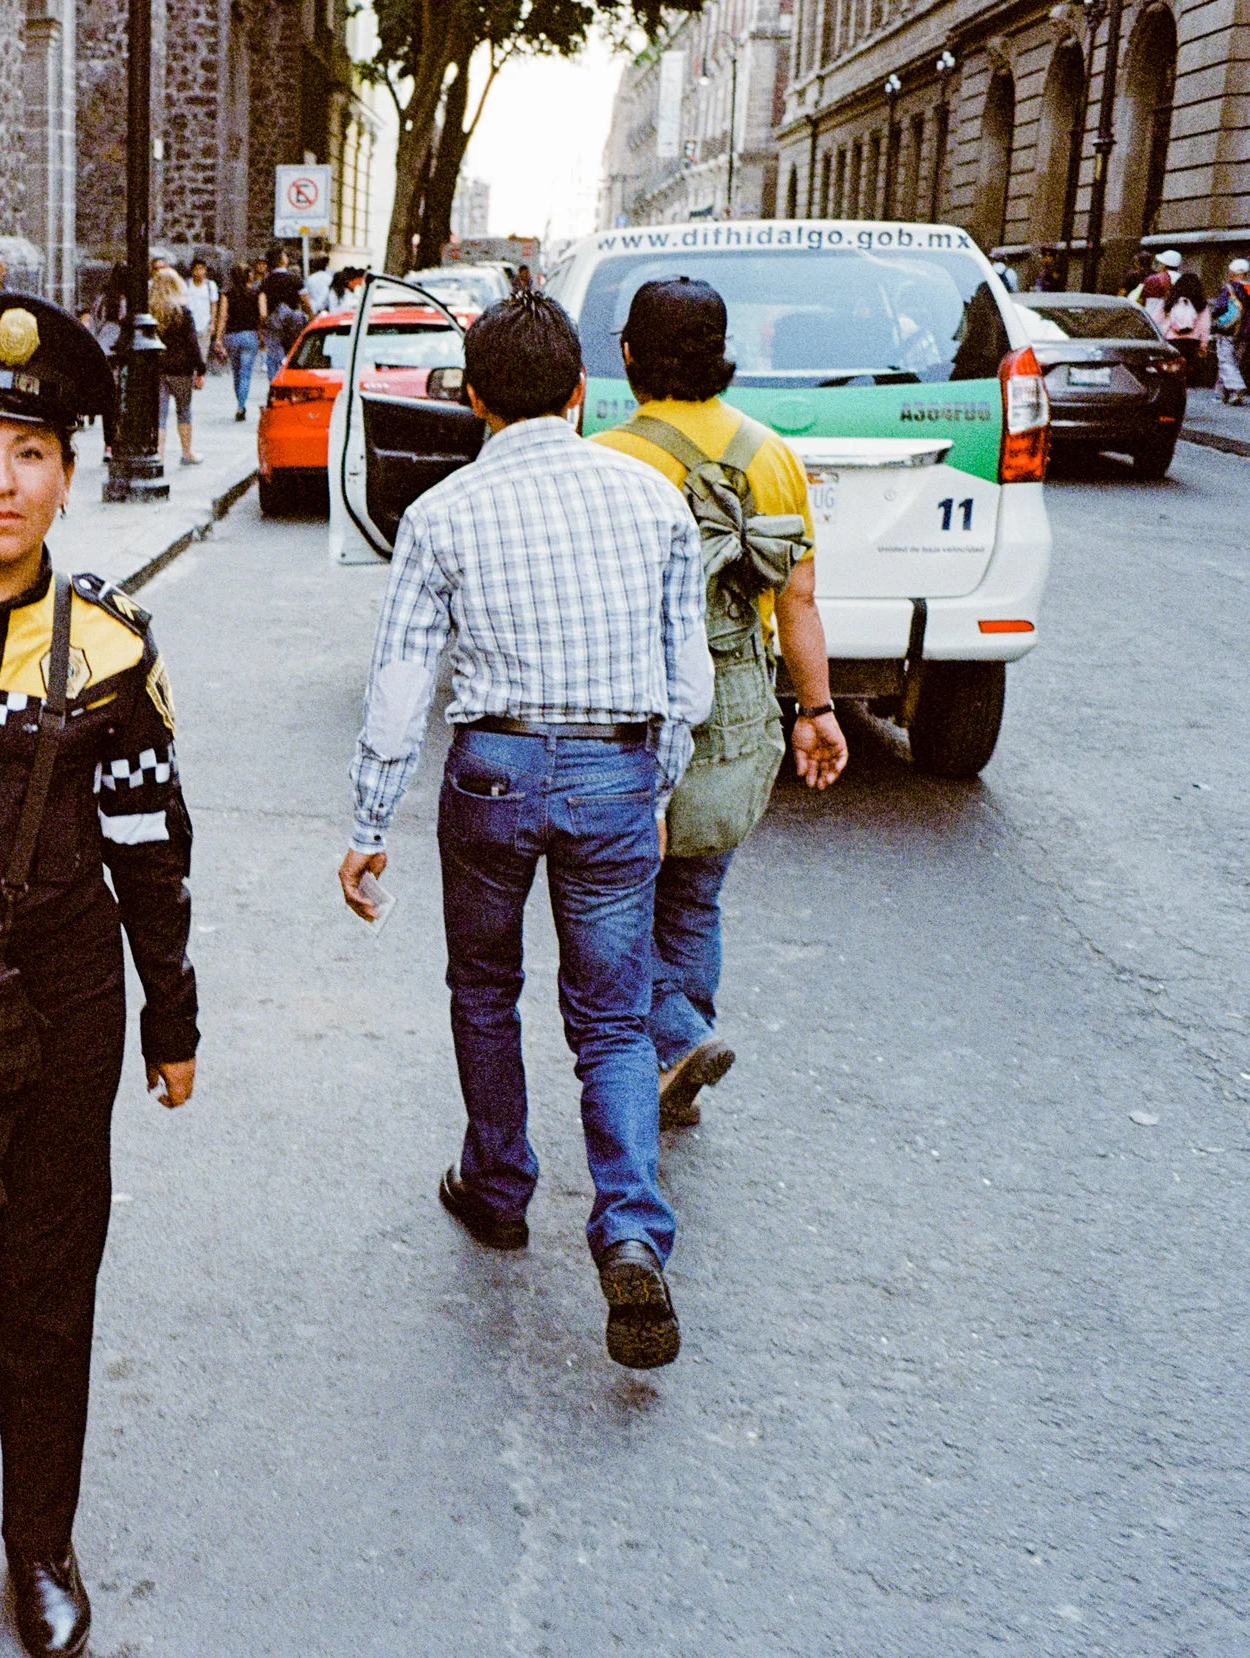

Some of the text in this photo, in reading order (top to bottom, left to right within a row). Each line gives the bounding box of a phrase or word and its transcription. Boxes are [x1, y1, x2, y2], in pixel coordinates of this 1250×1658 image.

[597, 226, 971, 250] www.difhidalgo.gob.mx
[808, 486, 835, 508] UG
[938, 498, 974, 531] 11
